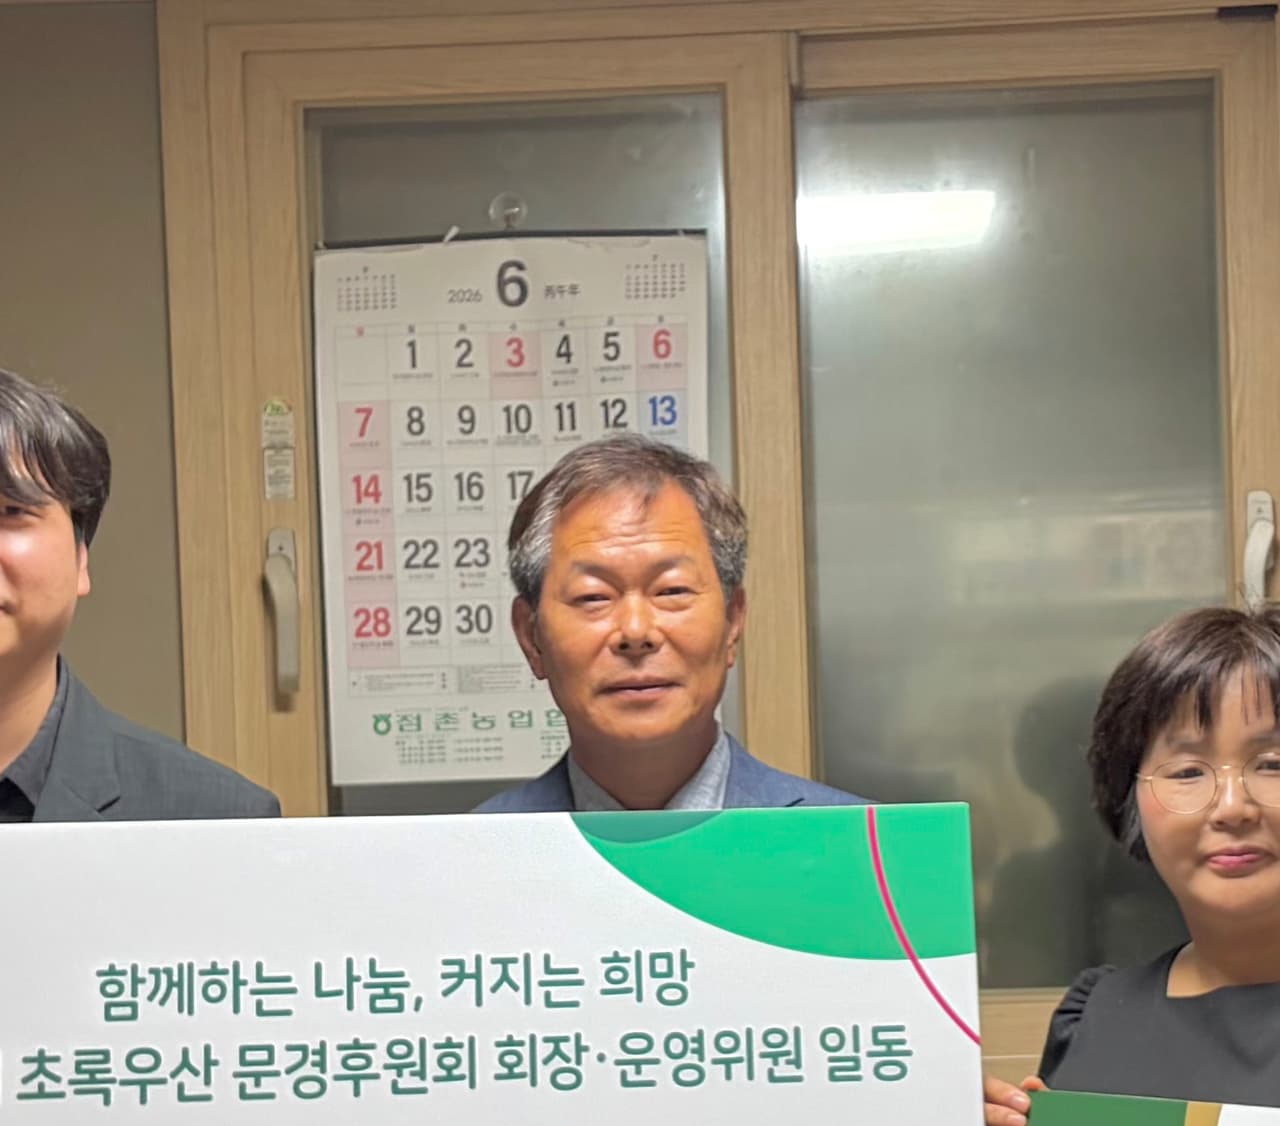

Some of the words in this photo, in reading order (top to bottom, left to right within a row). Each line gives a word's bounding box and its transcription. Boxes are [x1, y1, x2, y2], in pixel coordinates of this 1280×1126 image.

[448, 288, 483, 303] 2026
[497, 259, 528, 307] 6
[406, 339, 417, 368] 1
[455, 338, 474, 368] 2
[506, 337, 525, 367] 3
[556, 334, 573, 364] 4
[603, 332, 620, 361] 5
[653, 329, 672, 359] 6
[354, 407, 373, 438] 7
[406, 406, 425, 436] 8
[457, 405, 476, 435] 9
[502, 404, 532, 433] 10
[555, 401, 576, 432] 11
[600, 398, 628, 428] 12
[649, 395, 677, 426] 13
[352, 474, 382, 504] 14
[403, 473, 433, 503] 15
[454, 472, 484, 502] 16
[507, 471, 534, 501] 17
[356, 540, 384, 571] 21
[403, 539, 440, 569] 22
[453, 538, 491, 568] 23
[354, 607, 392, 638] 28
[405, 606, 442, 636] 29
[455, 604, 493, 635] 30
[96, 960, 298, 1022] 함께하는
[314, 956, 423, 1015] 나눔,
[440, 951, 586, 1010] 커지는
[599, 948, 696, 1007] 희망
[16, 1042, 220, 1107] 초록우산
[232, 1035, 477, 1100] 문경후원회
[820, 1023, 913, 1083] 일동
